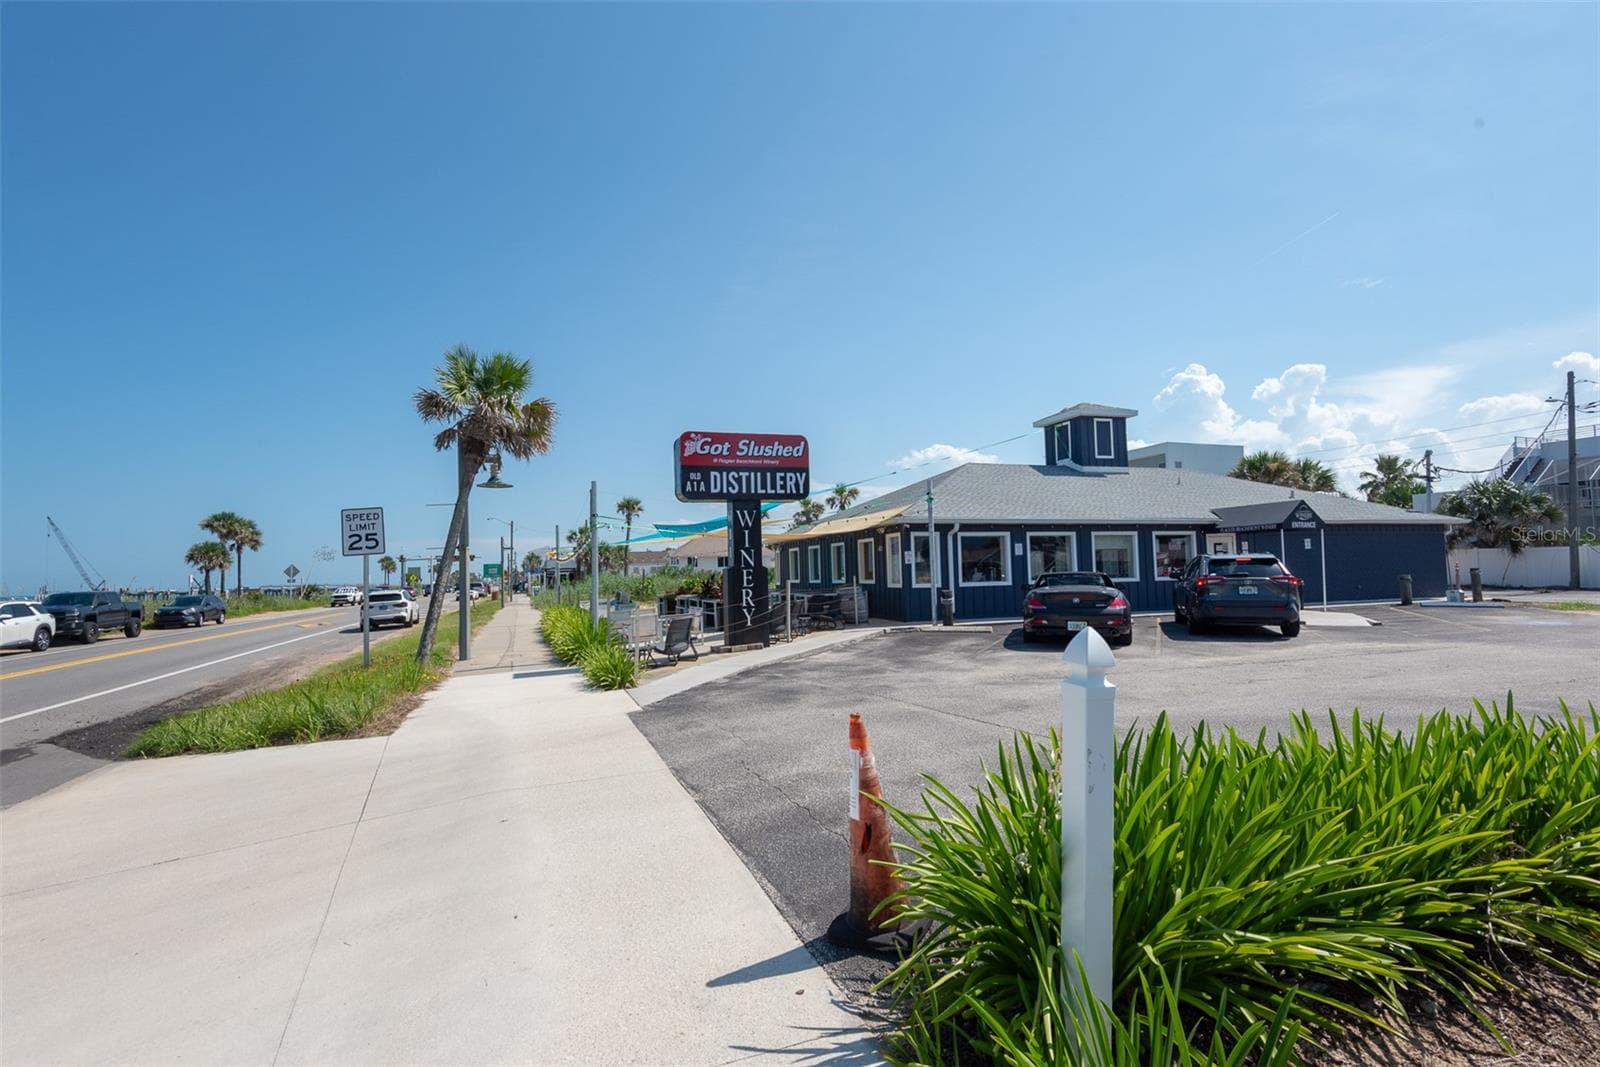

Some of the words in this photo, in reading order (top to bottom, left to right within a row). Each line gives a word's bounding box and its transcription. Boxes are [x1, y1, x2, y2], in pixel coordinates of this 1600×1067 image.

[697, 437, 731, 456] Got
[736, 439, 805, 457] Slushed
[689, 472, 702, 480] OLD
[710, 471, 806, 494] DISTILLERY
[345, 512, 380, 522] SPEED
[349, 522, 377, 532] LIMIT
[1291, 521, 1317, 529] ENTRANCE
[348, 532, 379, 551] 25
[736, 510, 757, 626] WINERY
